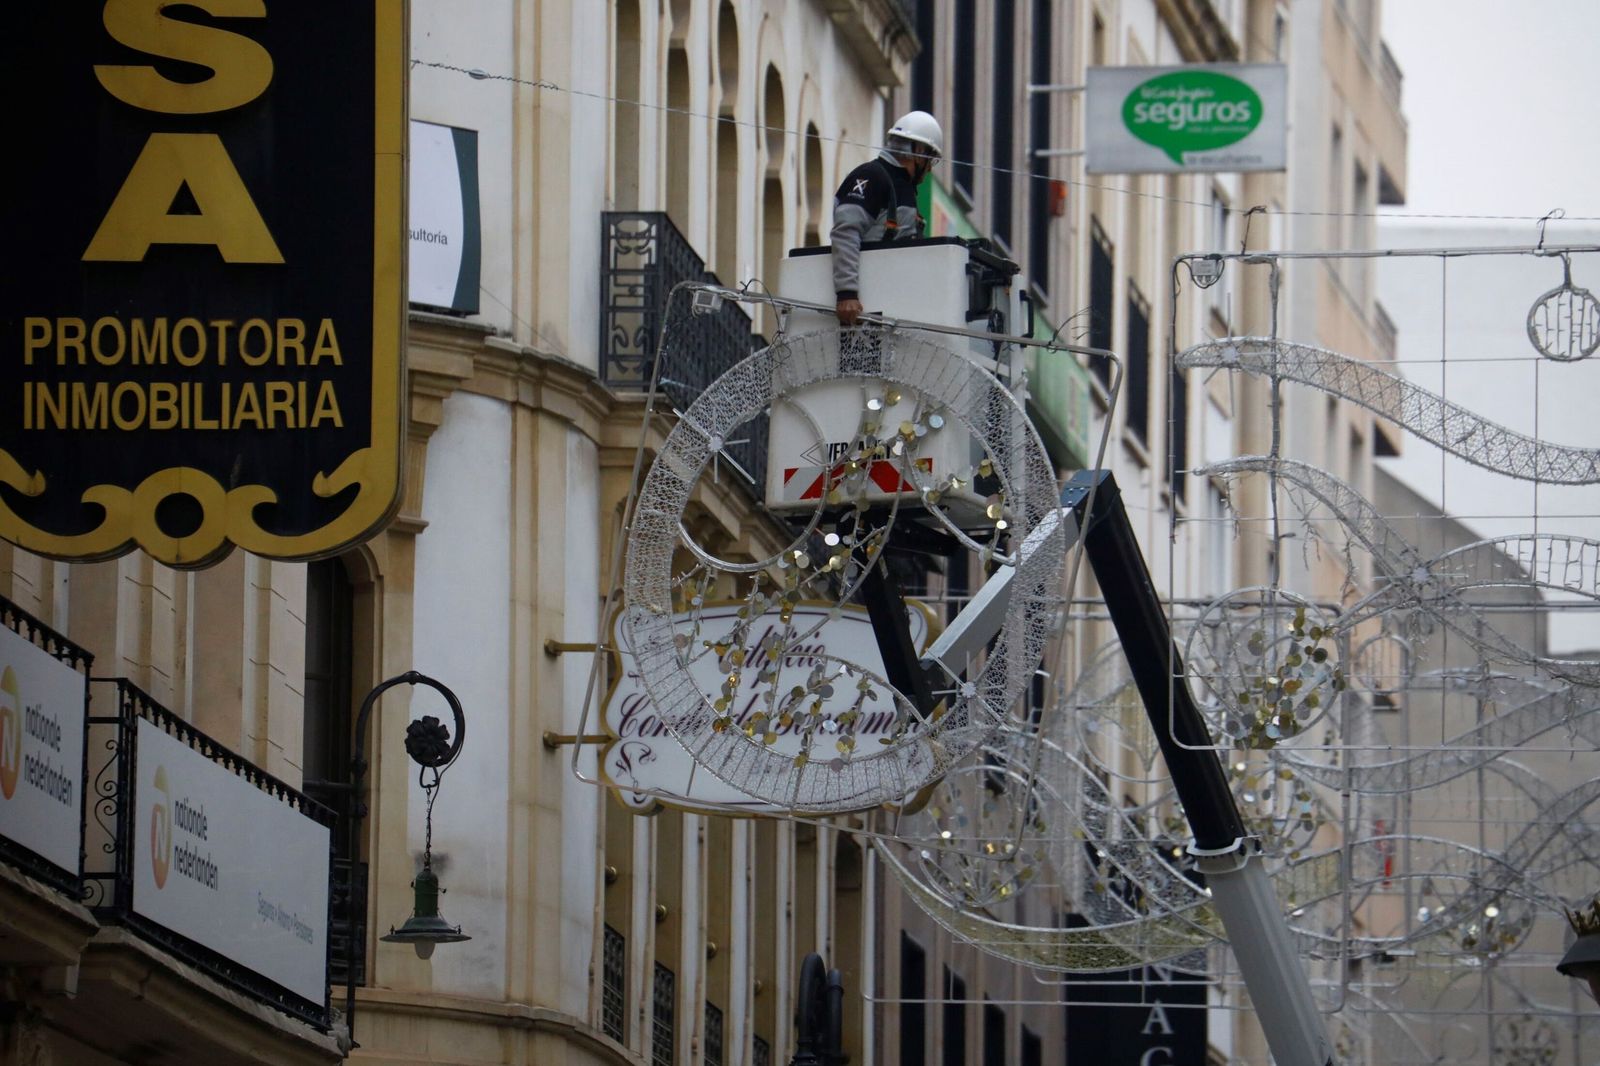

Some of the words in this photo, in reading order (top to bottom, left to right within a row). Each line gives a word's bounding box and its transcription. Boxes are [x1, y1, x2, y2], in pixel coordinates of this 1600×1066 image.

[1134, 100, 1251, 130] seguros
[23, 317, 343, 366] PROMOTORA
[23, 380, 344, 430] INMOBILIARIA
[25, 704, 61, 753] nationale
[24, 750, 72, 808] nederlanden
[174, 796, 208, 841] nationale
[173, 840, 218, 891] nederlanden
